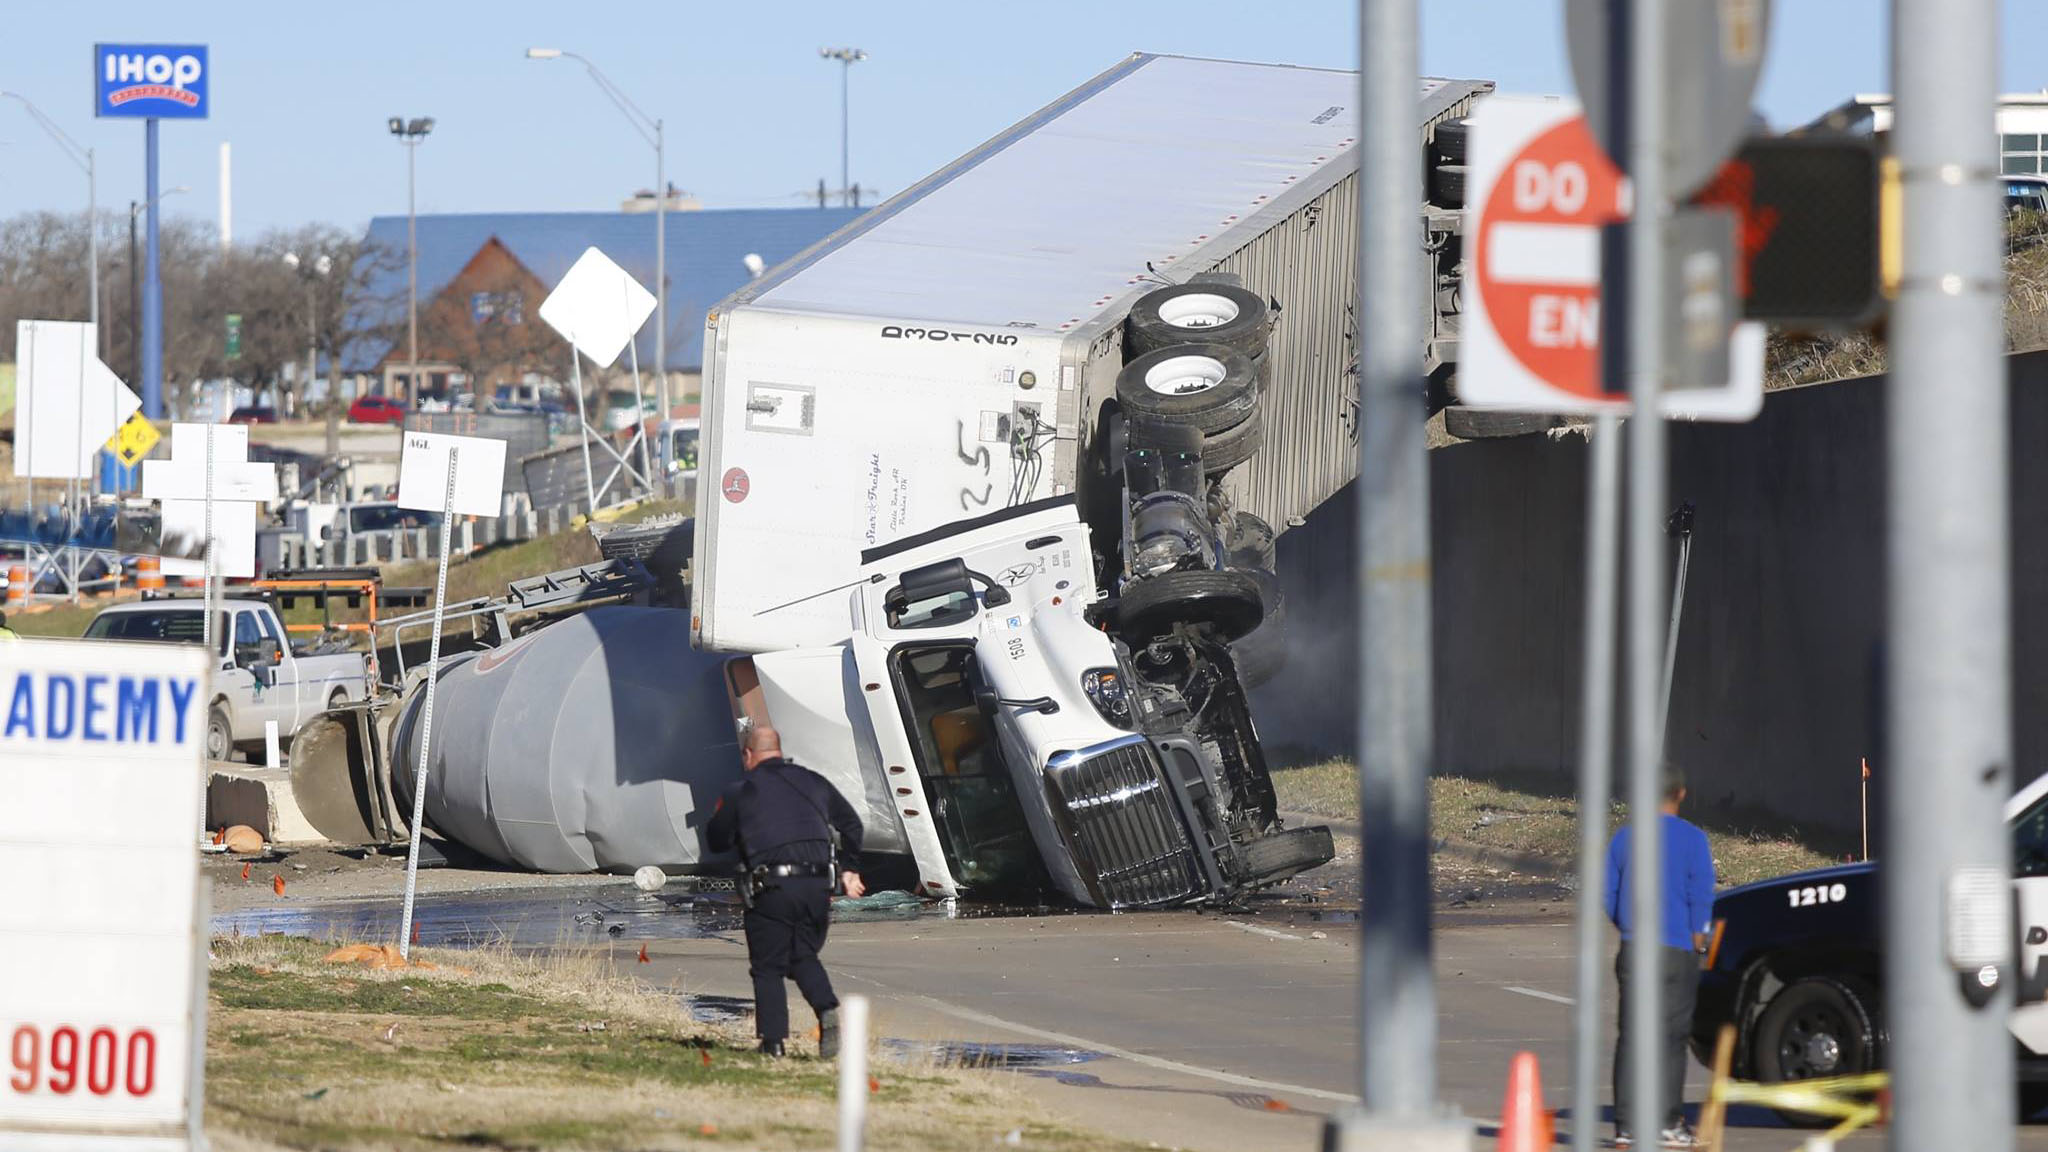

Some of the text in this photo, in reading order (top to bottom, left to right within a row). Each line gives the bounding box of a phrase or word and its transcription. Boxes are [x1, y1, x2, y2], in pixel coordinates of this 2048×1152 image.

[106, 54, 201, 90] IHOP
[1513, 159, 1589, 214] DO
[881, 326, 1018, 346] D30125
[409, 439, 431, 450] AGL
[1008, 637, 1026, 661] 1508
[4, 673, 195, 744] ADEMY
[1787, 883, 1847, 908] 1210
[10, 1024, 156, 1097] 9900
